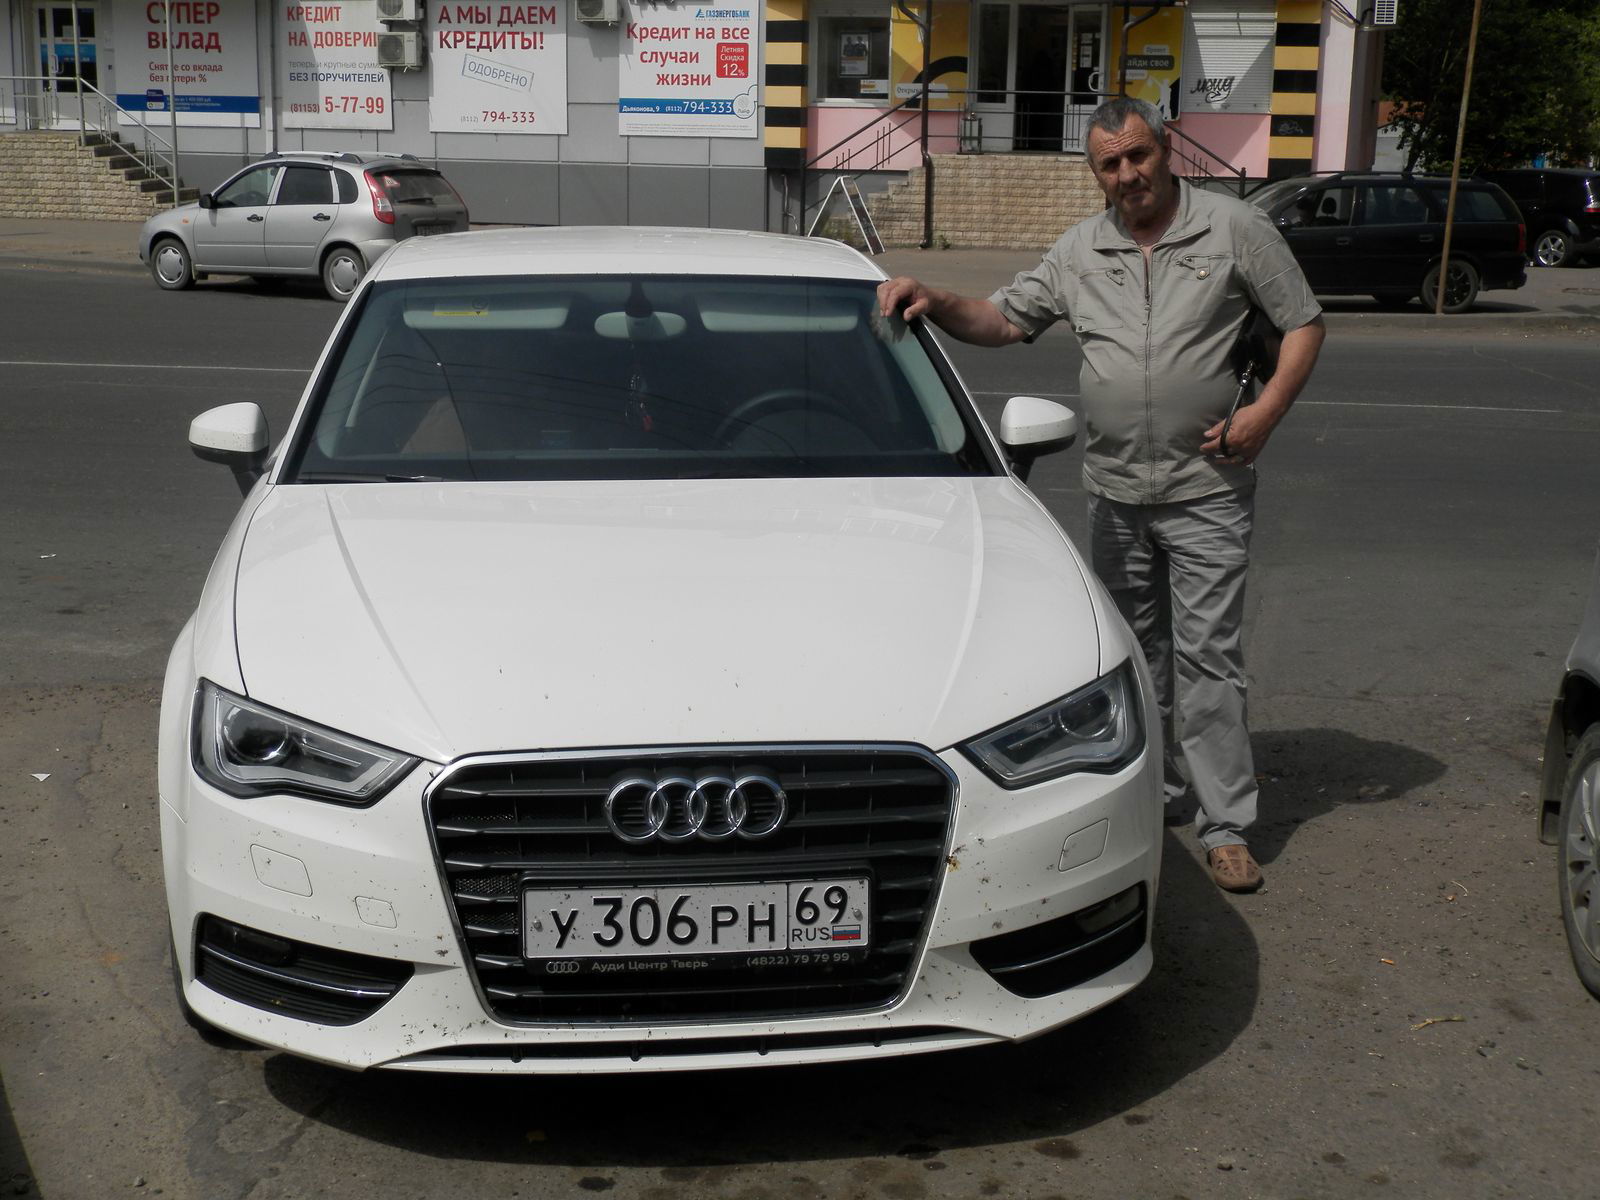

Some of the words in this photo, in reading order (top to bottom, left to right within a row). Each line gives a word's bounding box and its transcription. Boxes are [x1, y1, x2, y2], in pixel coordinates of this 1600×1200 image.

[146, 1, 220, 24] СУПЕР
[287, 6, 341, 23] КРЕДИТ
[438, 5, 452, 24] А
[457, 6, 491, 25] МЫ
[497, 6, 556, 27] ДАЕМ
[288, 31, 308, 47] НА
[626, 22, 690, 43] Кредит
[695, 27, 715, 40] на
[721, 27, 750, 40] все
[147, 31, 222, 53] вклад
[440, 31, 544, 52] КРЕДИТЫ!
[149, 61, 179, 71] Сняте
[193, 63, 223, 72] вклада
[289, 61, 315, 70] теперь
[323, 62, 357, 70] крупные
[359, 62, 381, 70] сумм
[640, 51, 699, 67] случаи
[1126, 58, 1148, 67] айди
[150, 73, 164, 82] без
[198, 73, 207, 82] %
[289, 72, 309, 82] БЕЗ
[311, 72, 385, 83] ПОРУЧИТЕЛЕЙ
[467, 61, 528, 88] ОДОБРЕНО
[722, 63, 745, 76] 12%
[656, 74, 711, 86] жизни
[290, 103, 320, 114] (81153)
[325, 96, 384, 114] 5-77-99
[683, 101, 733, 113] 794-333
[482, 111, 535, 123] 794-333
[795, 885, 849, 926] 69
[792, 927, 830, 942] RUS
[592, 961, 624, 973] Ауди
[628, 960, 668, 972] Центр
[671, 959, 709, 970] Тверь
[747, 954, 789, 967] (4822)
[793, 954, 809, 964] 79
[814, 953, 829, 963] 79
[833, 951, 849, 961] 99
